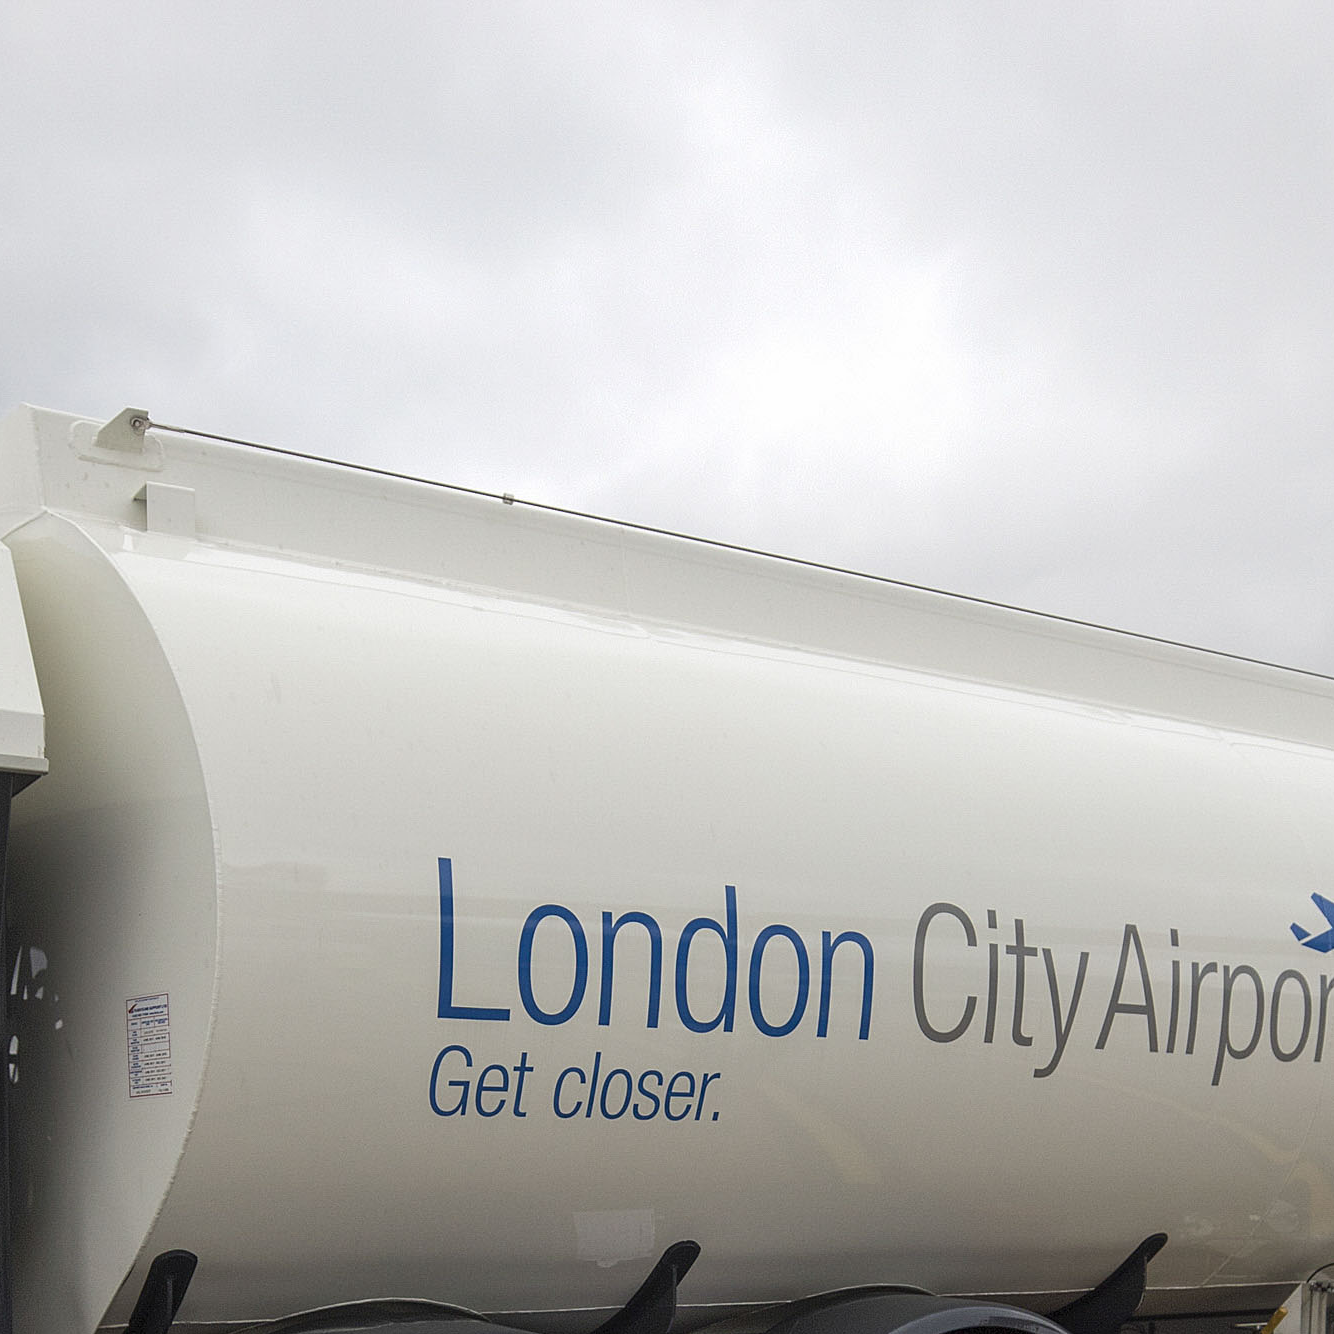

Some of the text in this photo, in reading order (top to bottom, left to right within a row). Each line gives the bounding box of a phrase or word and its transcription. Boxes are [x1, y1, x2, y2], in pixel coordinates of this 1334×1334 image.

[437, 857, 875, 1041] London
[913, 901, 1090, 1079] City
[428, 1044, 722, 1122] Get closer.
